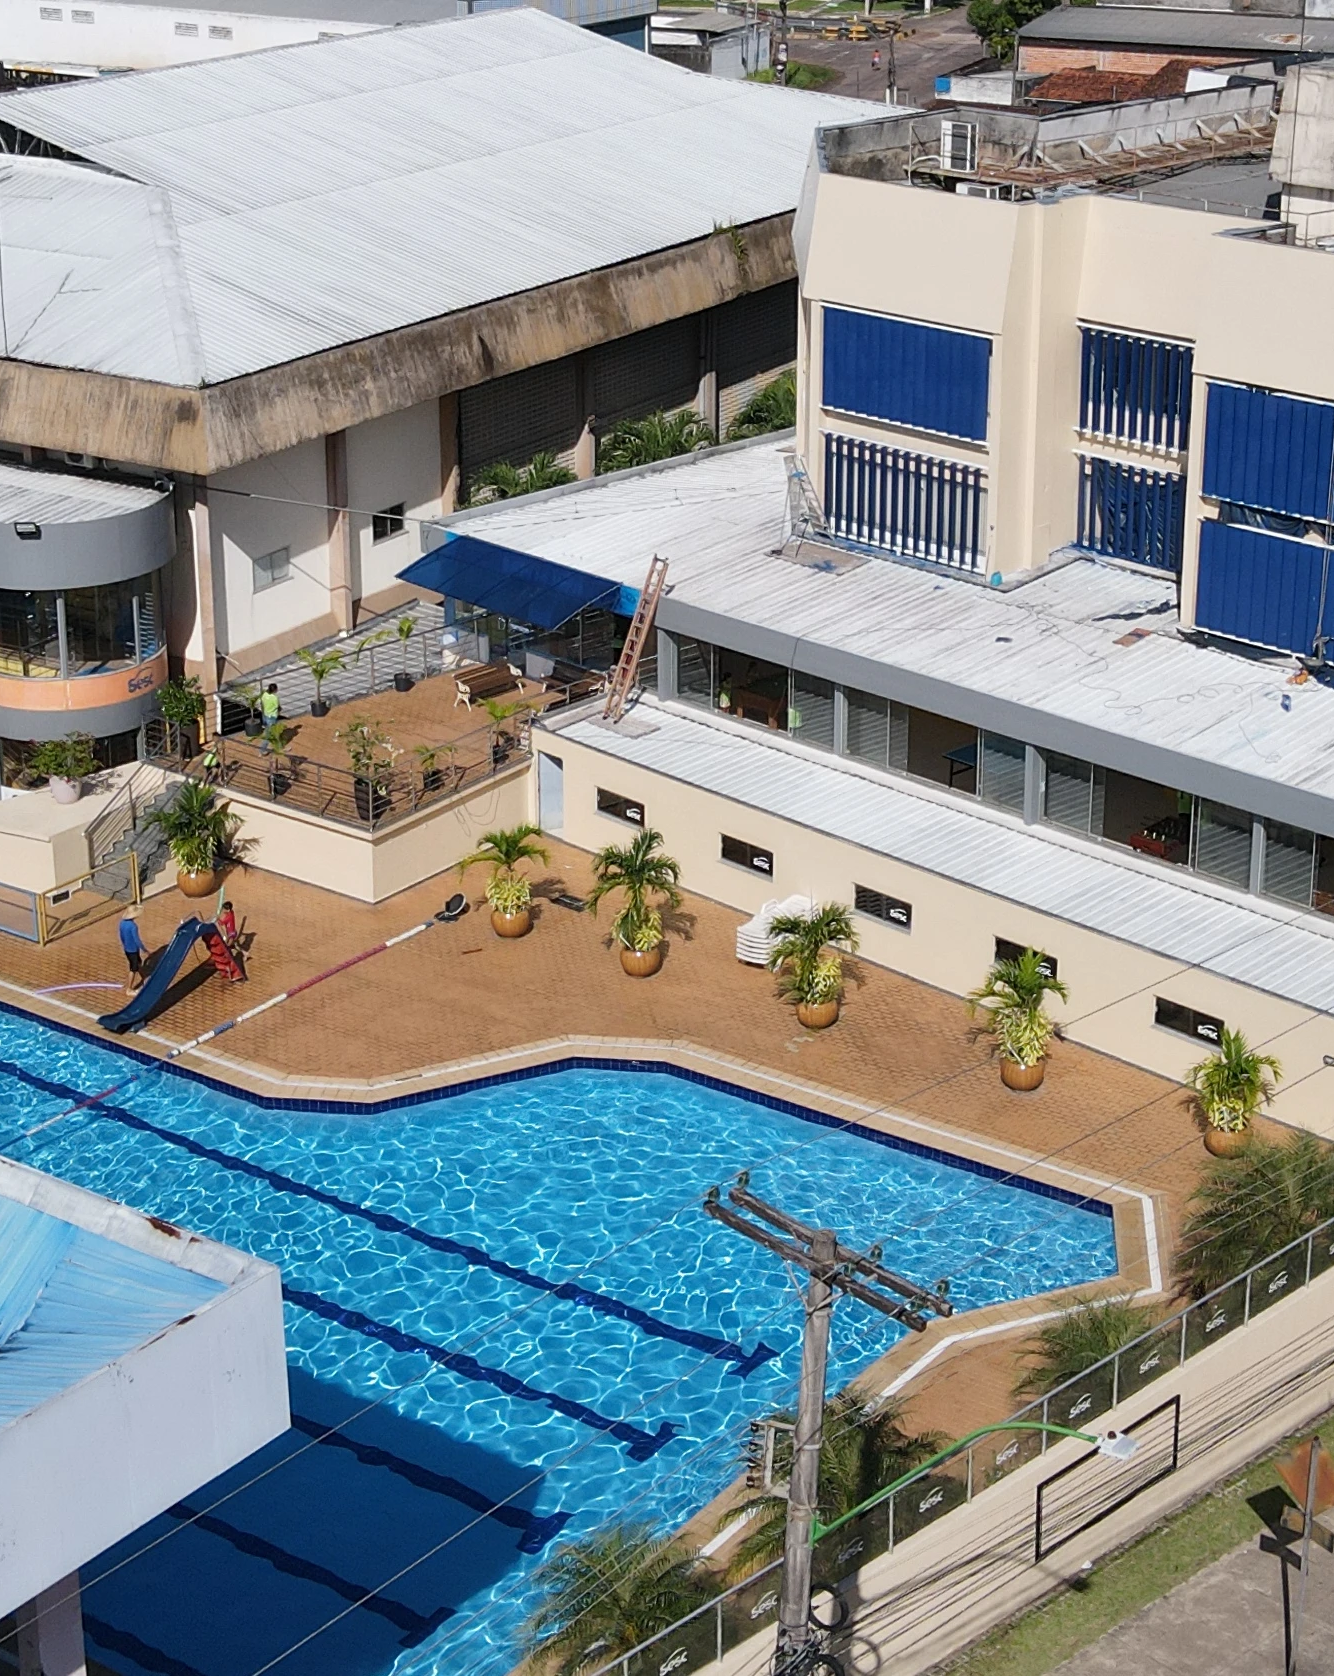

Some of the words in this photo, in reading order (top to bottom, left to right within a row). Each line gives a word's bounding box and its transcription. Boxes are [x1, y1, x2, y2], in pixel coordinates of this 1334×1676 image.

[128, 672, 154, 693] Sesc
[919, 1490, 945, 1513] Sesc
[750, 1594, 778, 1620] Sesc
